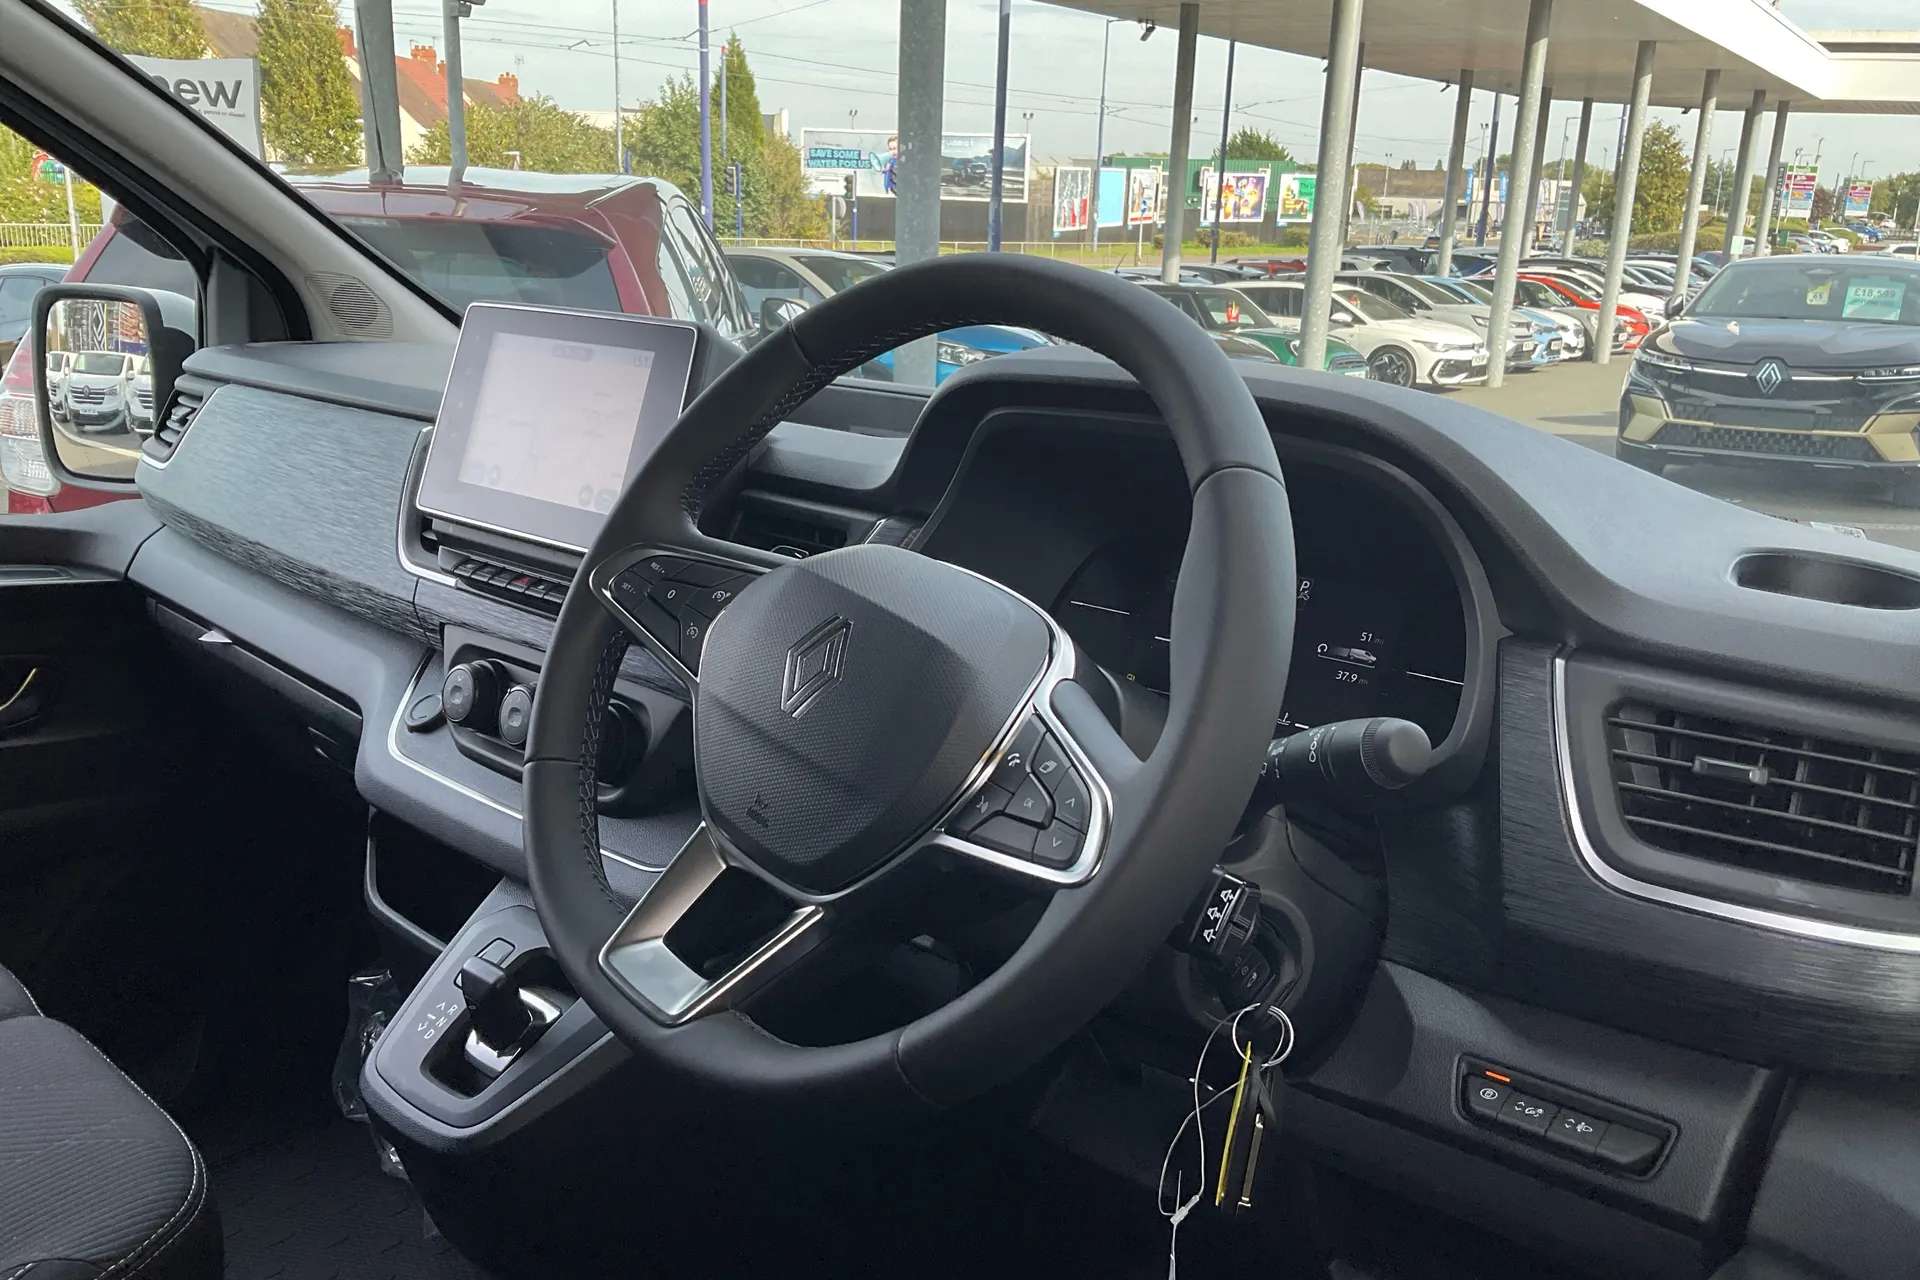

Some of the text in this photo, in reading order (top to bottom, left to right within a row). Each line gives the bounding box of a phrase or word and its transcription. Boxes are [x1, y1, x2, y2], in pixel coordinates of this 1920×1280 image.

[811, 148, 860, 160] SAVE SOME
[808, 160, 872, 169] WATER FOR US
[1299, 579, 1310, 592] P
[1359, 631, 1373, 643] 51
[1335, 669, 1358, 684] 37.9
[446, 1004, 458, 1016] R
[423, 1028, 435, 1040] D
